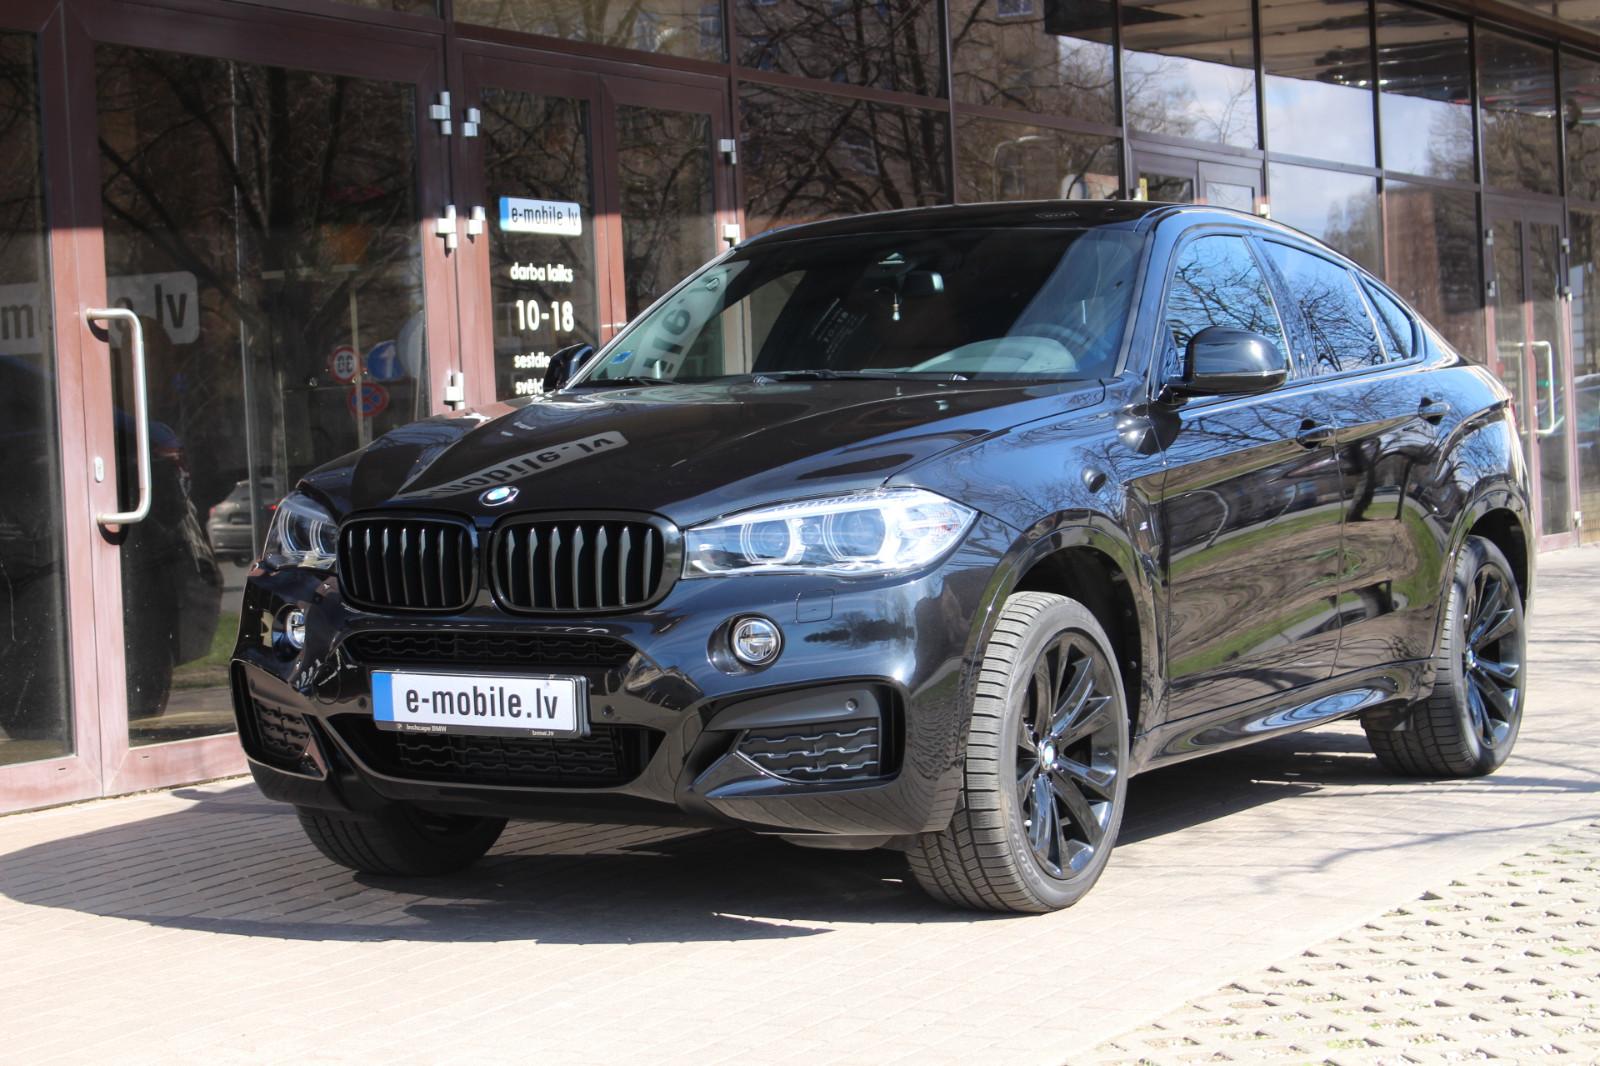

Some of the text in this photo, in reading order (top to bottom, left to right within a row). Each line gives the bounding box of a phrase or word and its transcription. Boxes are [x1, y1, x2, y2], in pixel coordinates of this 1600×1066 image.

[511, 205, 578, 226] e-mobilelv
[510, 261, 574, 283] darba laiks
[515, 300, 575, 332] 10-18
[405, 685, 559, 719] e-mobile.lv
